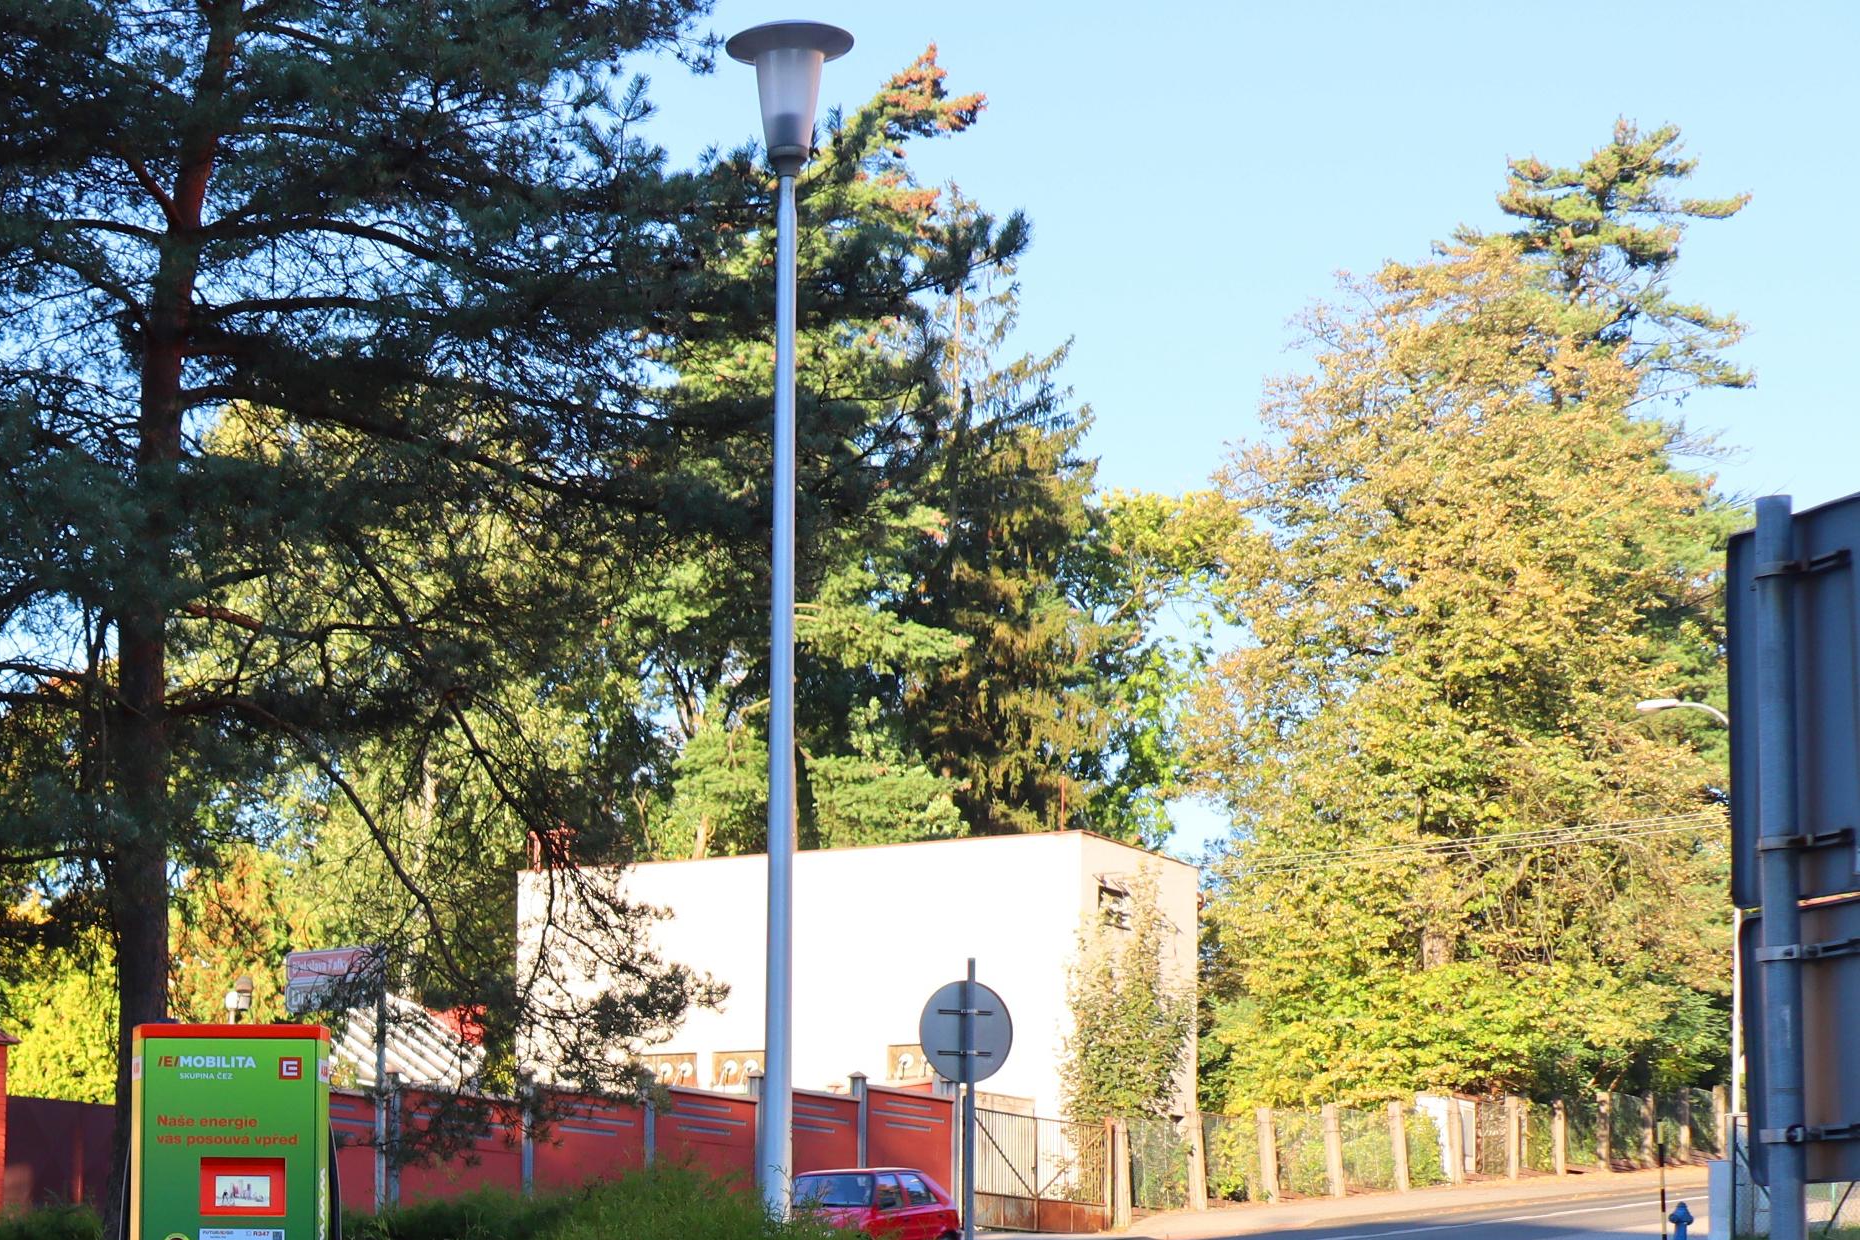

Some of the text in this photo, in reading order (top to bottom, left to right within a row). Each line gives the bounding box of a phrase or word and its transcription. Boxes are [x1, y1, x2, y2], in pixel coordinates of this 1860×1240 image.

[179, 1071, 233, 1080] SKUPINA ČEZ
[157, 1115, 257, 1129] Naše energie
[187, 1133, 250, 1147] posouvá
[255, 1133, 298, 1147] vpřed
